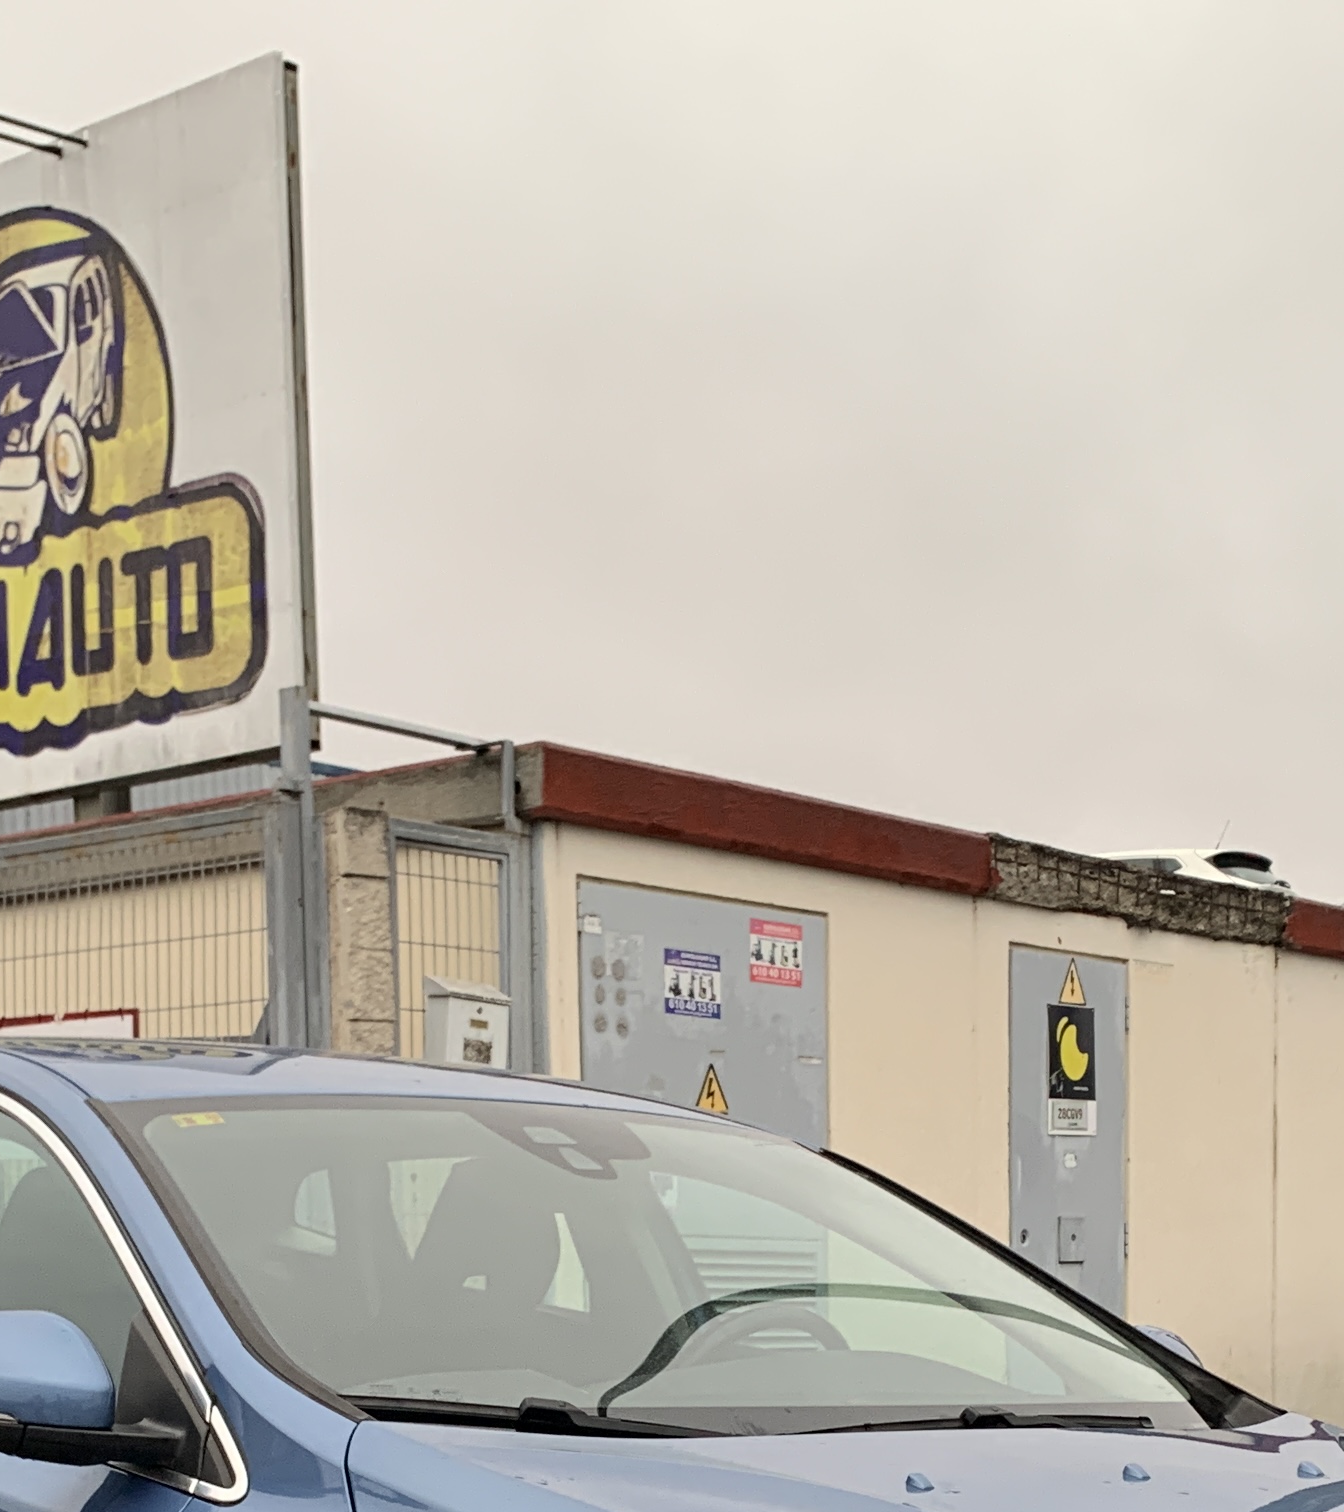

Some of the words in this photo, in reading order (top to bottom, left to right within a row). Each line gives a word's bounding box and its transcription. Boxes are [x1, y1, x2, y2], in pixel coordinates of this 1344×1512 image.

[769, 967, 779, 978] 40
[668, 998, 685, 1010] 610
[686, 1000, 697, 1011] 40
[697, 1002, 707, 1013] 13
[708, 1003, 718, 1014] 51
